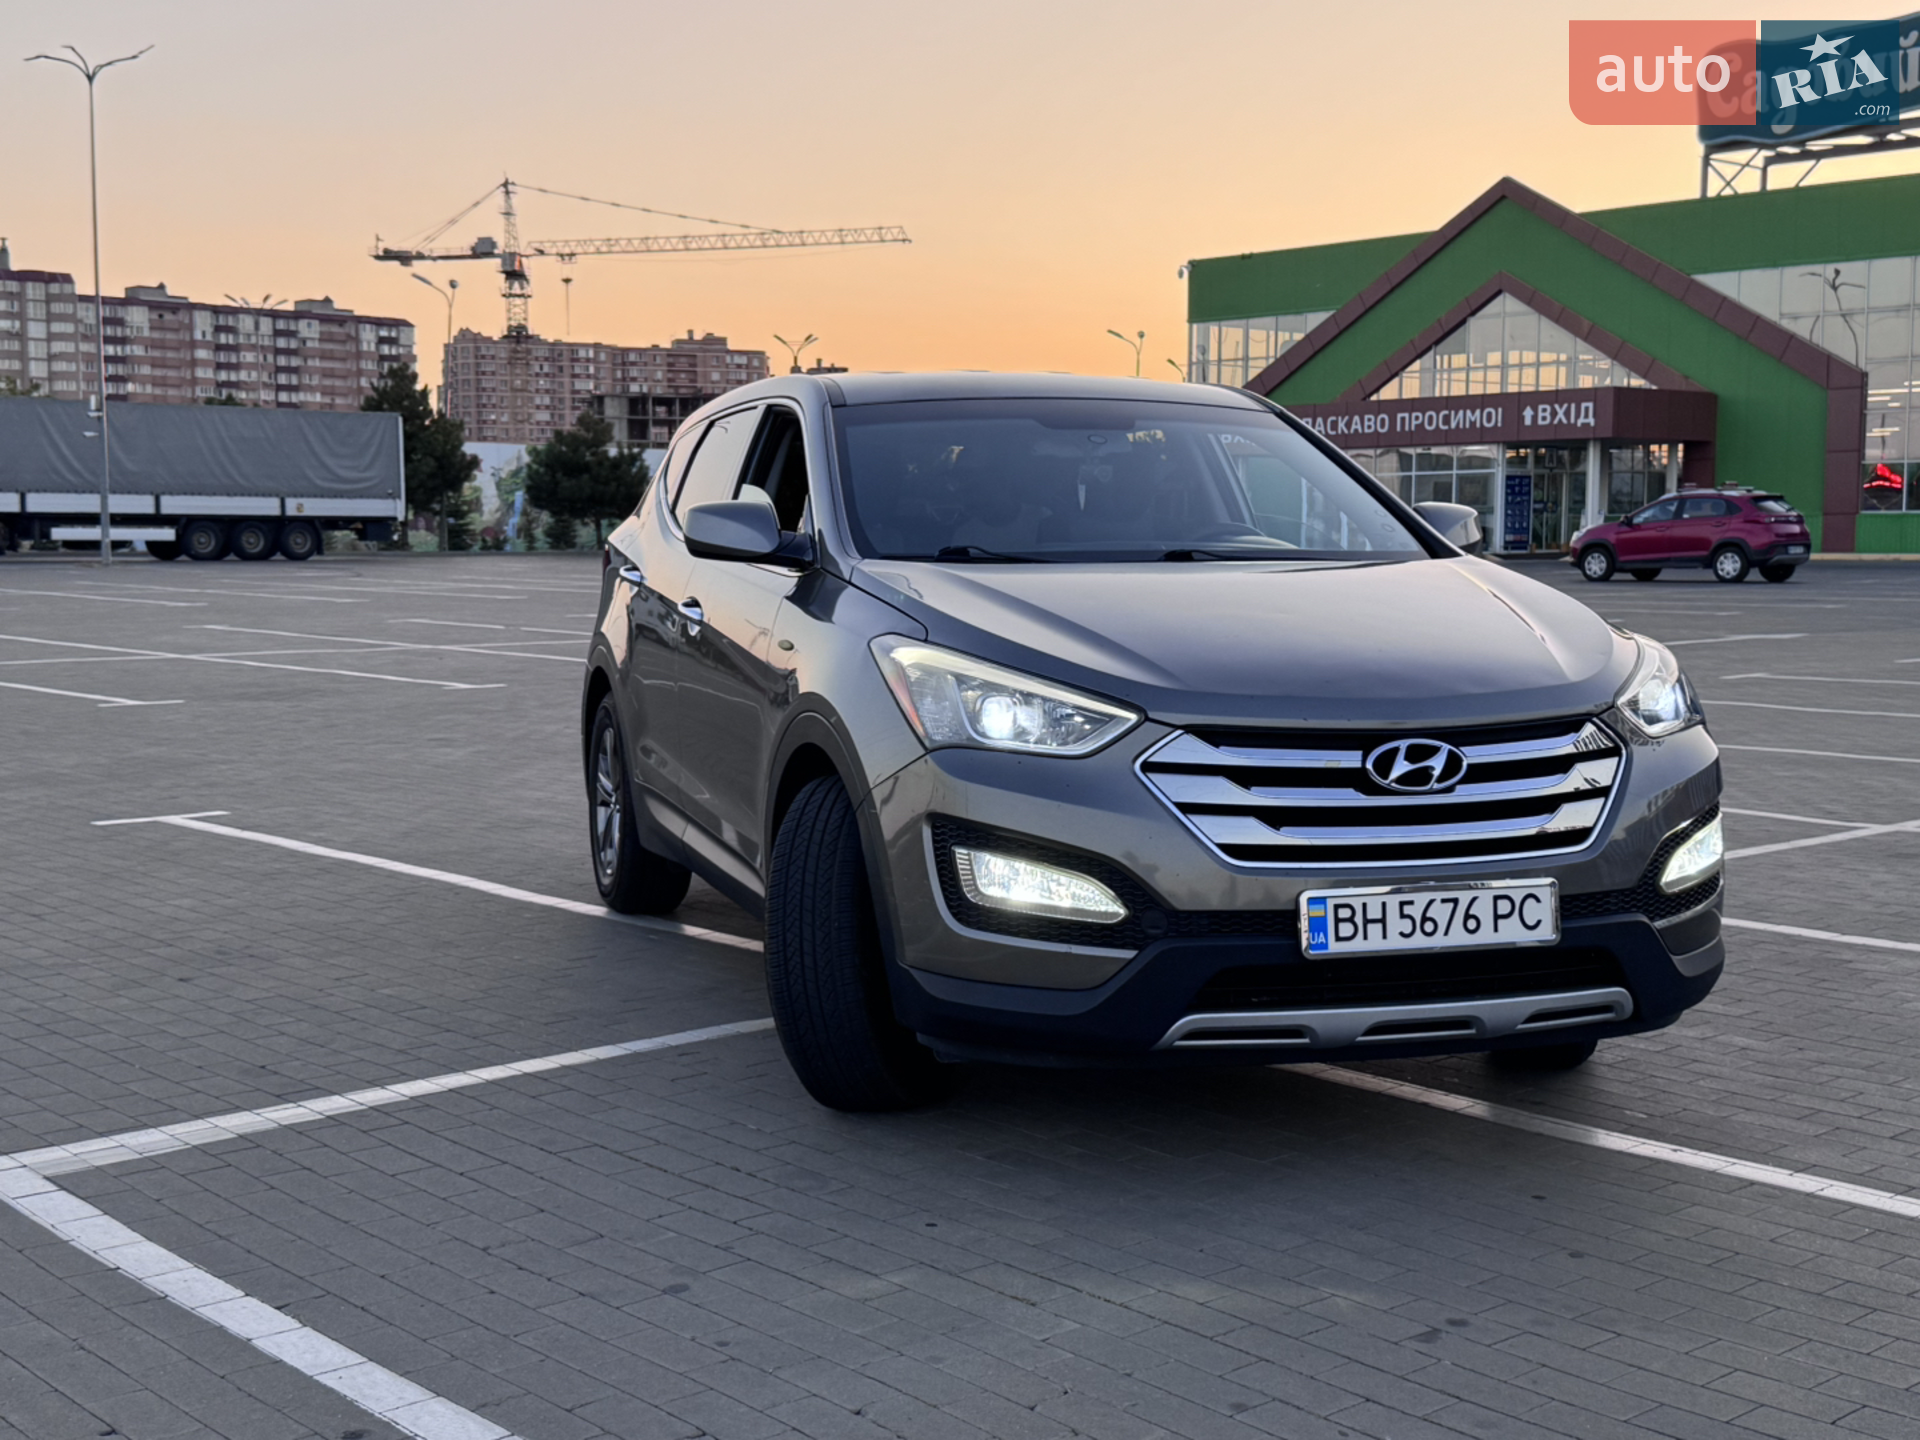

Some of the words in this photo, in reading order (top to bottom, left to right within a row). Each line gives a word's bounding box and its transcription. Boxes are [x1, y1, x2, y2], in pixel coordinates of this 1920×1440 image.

[1396, 407, 1502, 433] ПРОСИМО!
[1537, 402, 1596, 427] ВХІД
[1333, 901, 1388, 943] BH
[1398, 896, 1482, 939] 5676
[1493, 892, 1543, 934] PC
[1309, 931, 1327, 945] UA
